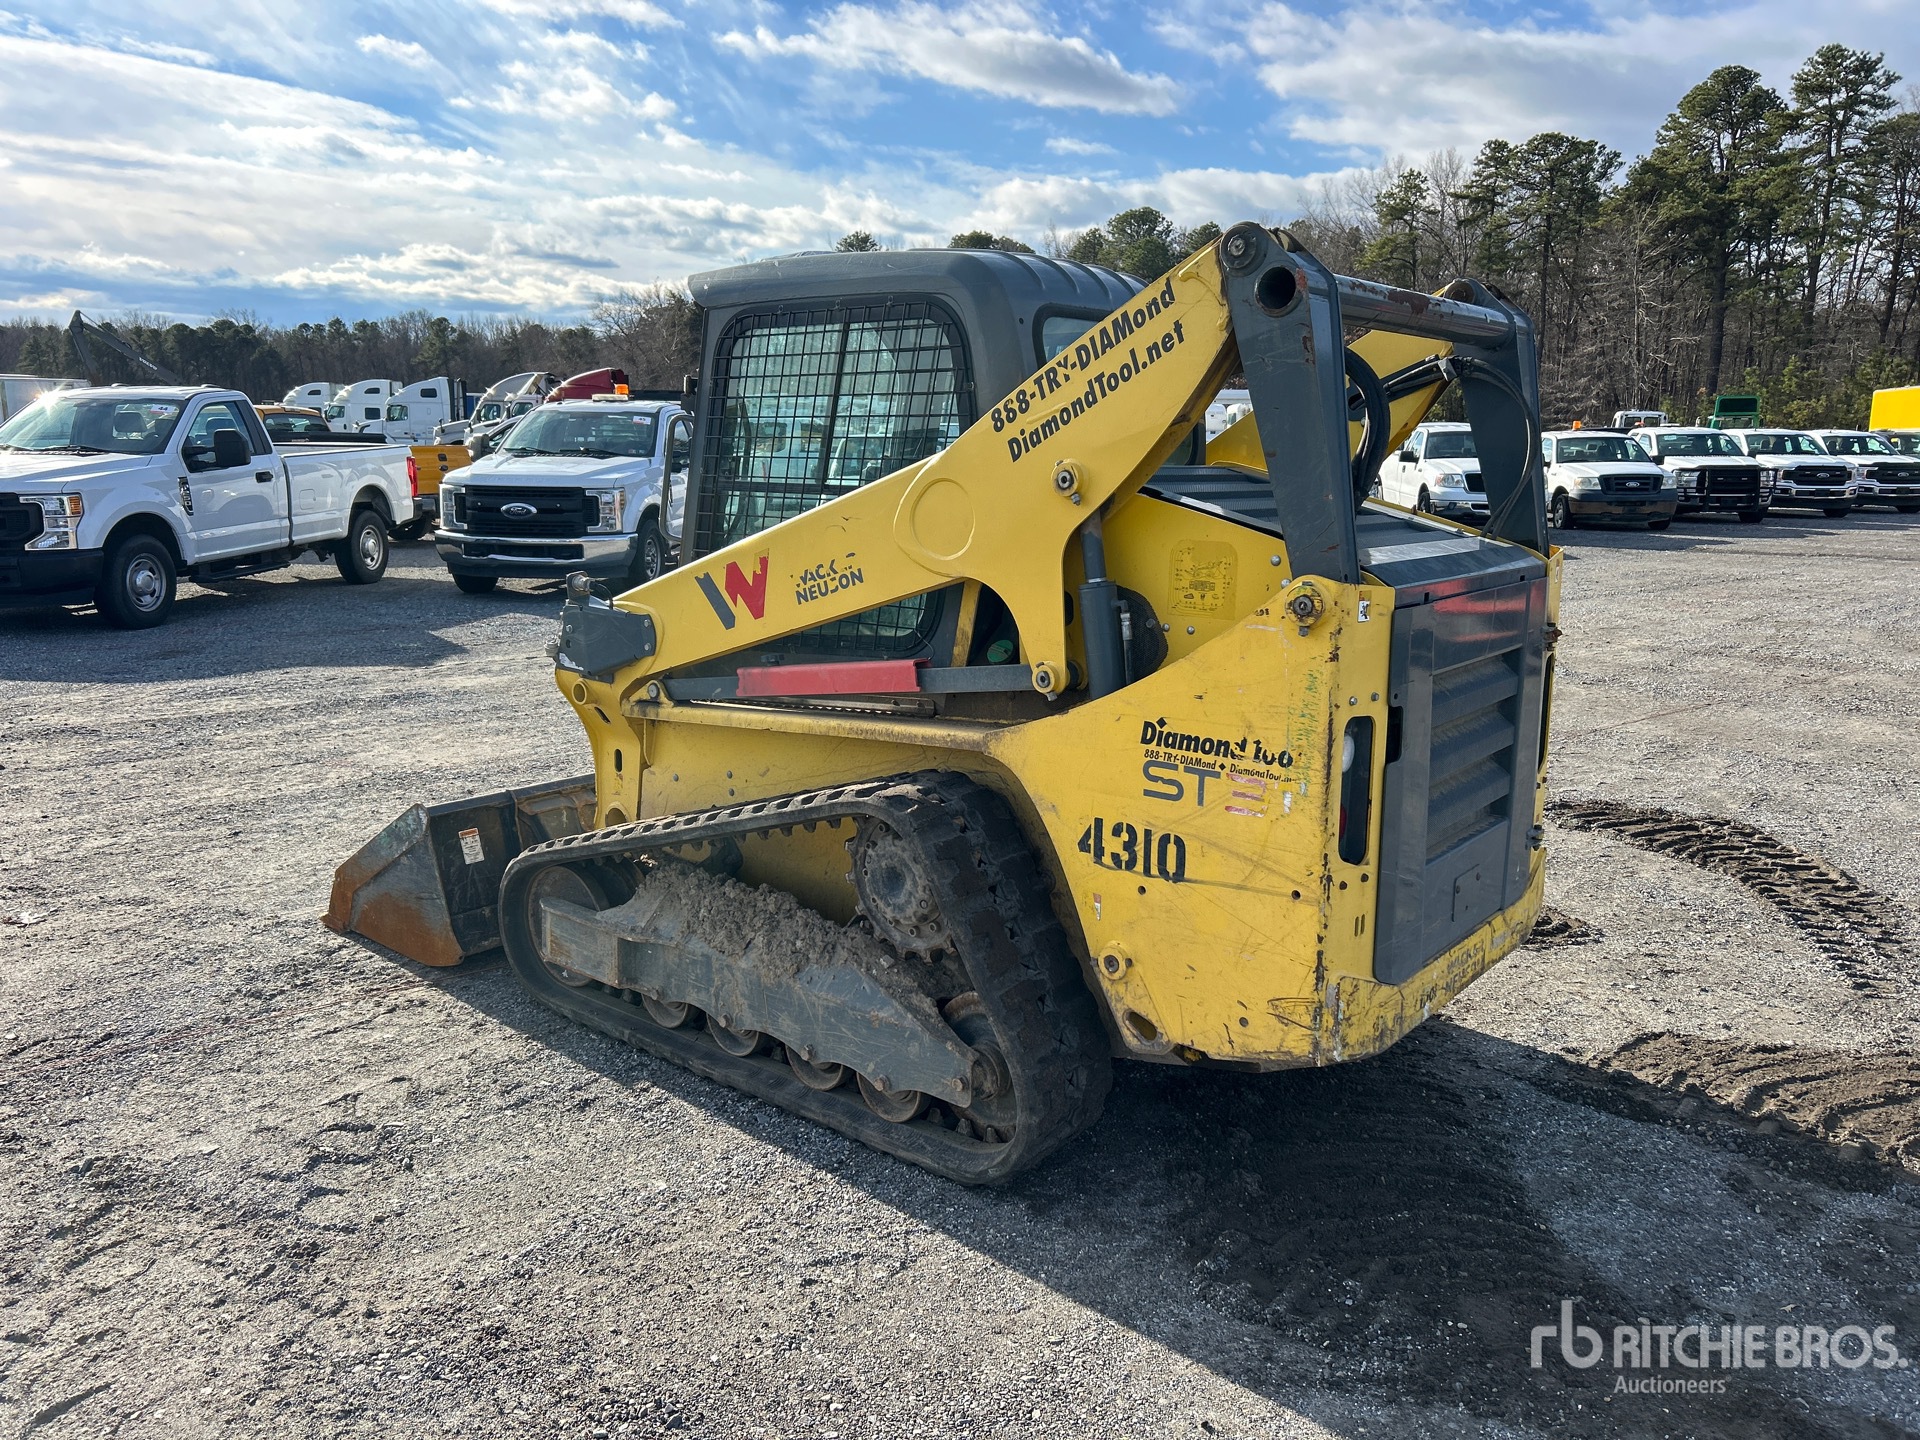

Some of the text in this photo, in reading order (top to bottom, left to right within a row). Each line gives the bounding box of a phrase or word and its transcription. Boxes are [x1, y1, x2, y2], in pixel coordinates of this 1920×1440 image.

[1007, 319, 1185, 463] DiamondTool.net
[790, 552, 856, 588] WACK
[1140, 717, 1295, 768] Diamond Too
[1077, 816, 1186, 884] 4310
